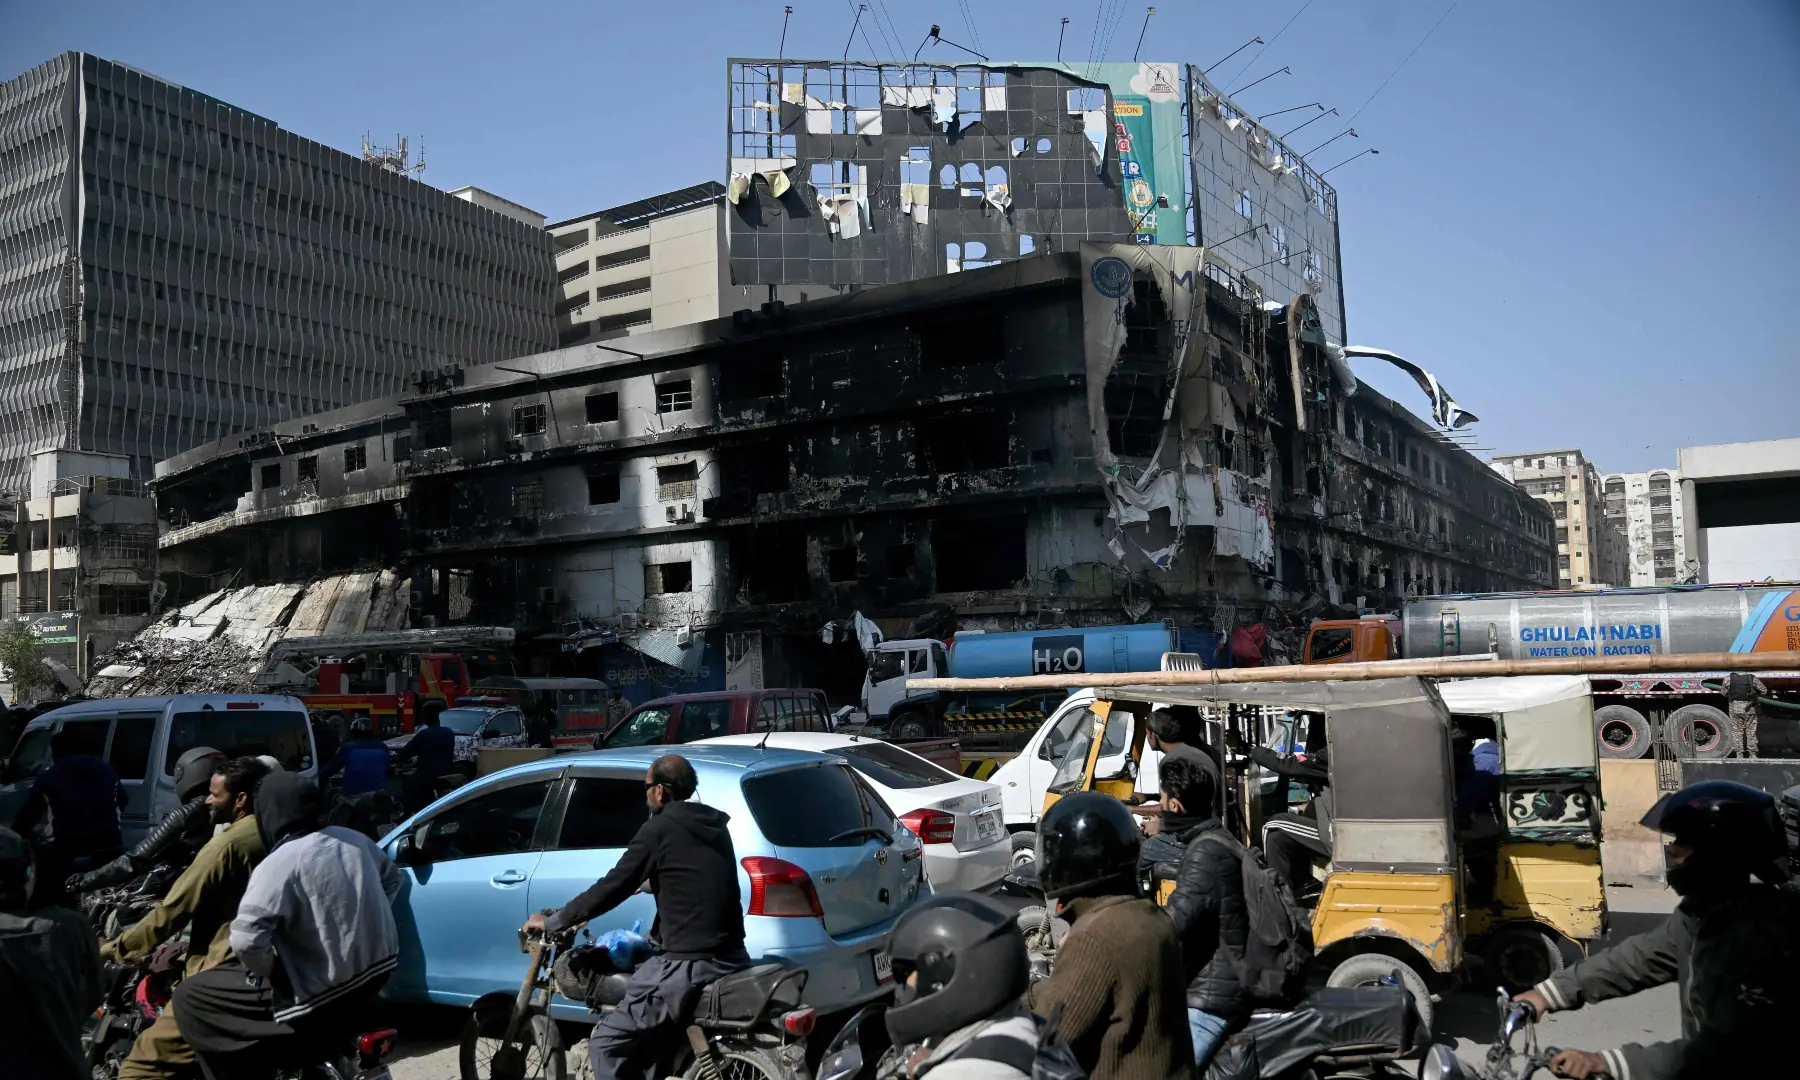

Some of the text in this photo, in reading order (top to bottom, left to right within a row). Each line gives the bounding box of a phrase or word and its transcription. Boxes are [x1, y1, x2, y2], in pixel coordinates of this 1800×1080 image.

[61, 612, 74, 620] PPF
[1610, 624, 1662, 641] NABI
[1530, 645, 1652, 657] WATER CONRACTOR
[1034, 646, 1082, 672] H2O
